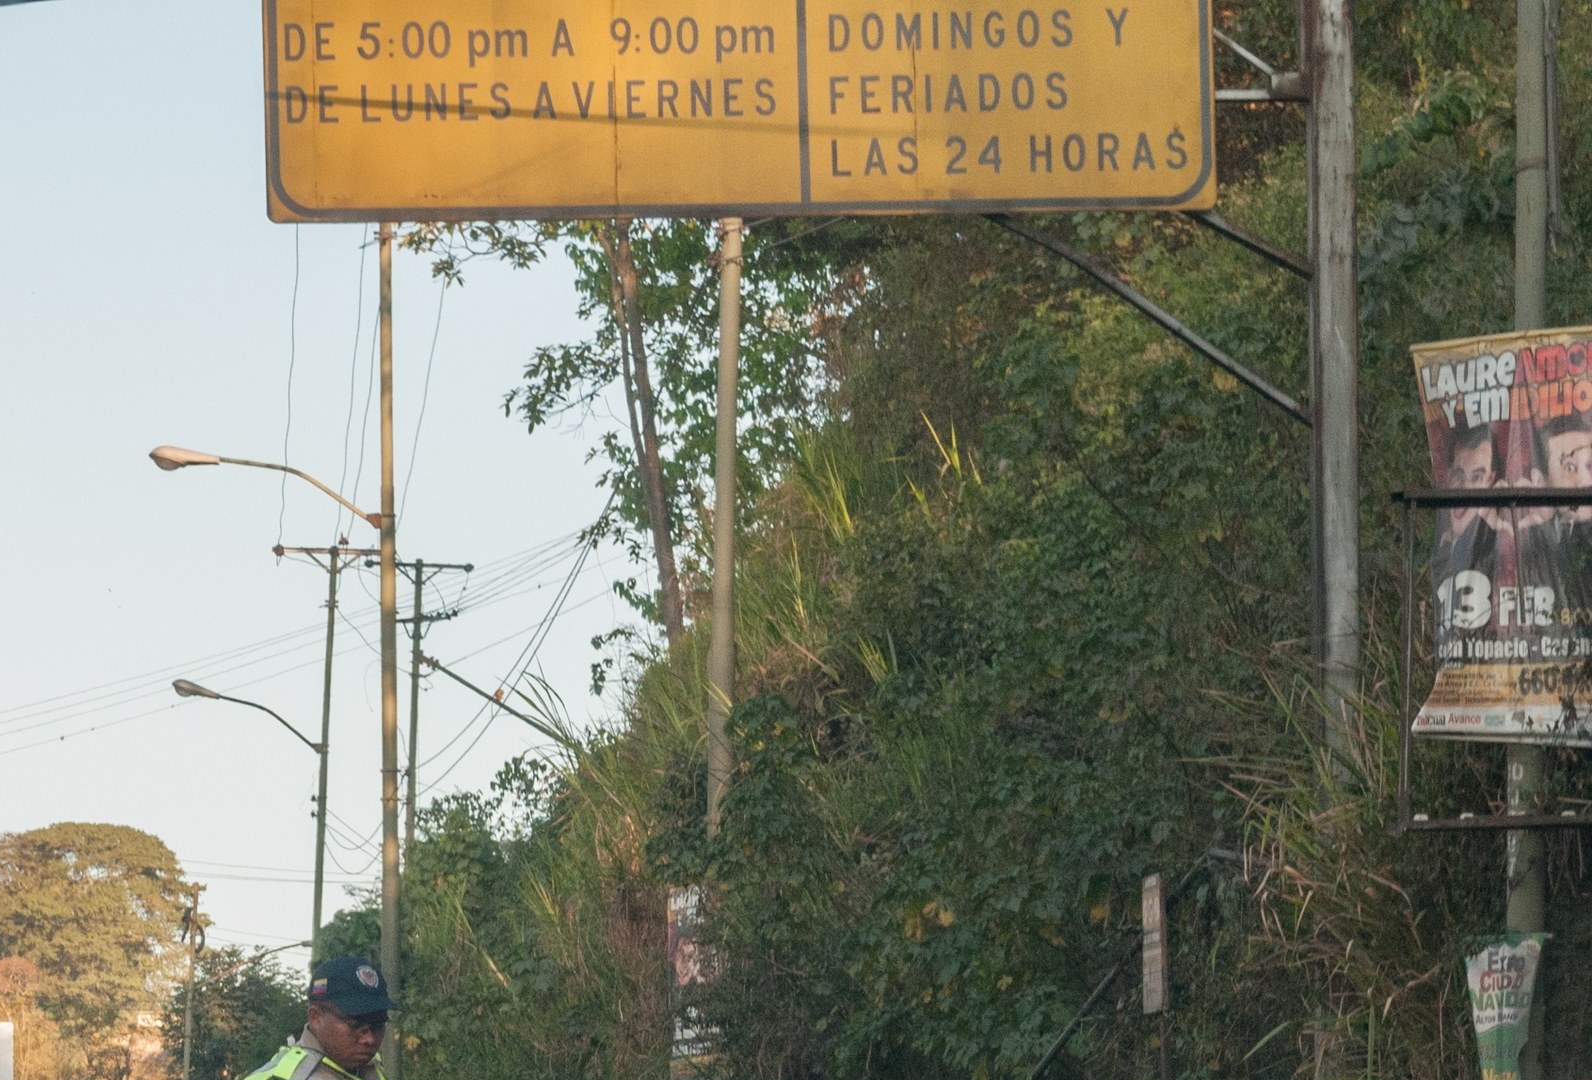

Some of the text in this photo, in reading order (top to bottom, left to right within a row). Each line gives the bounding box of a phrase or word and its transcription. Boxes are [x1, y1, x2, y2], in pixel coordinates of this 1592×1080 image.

[283, 16, 775, 68] DE 5:00 pm A 9:00 pm
[828, 7, 1129, 53] DOMINGOS Y
[285, 84, 339, 124] DE
[360, 81, 512, 124] LUNES
[571, 77, 777, 120] VIERNES
[828, 72, 1069, 115] FERIADOS
[831, 130, 1189, 178] LAS 24 HORAS
[1436, 569, 1492, 631] 13
[1499, 585, 1556, 627] FEB
